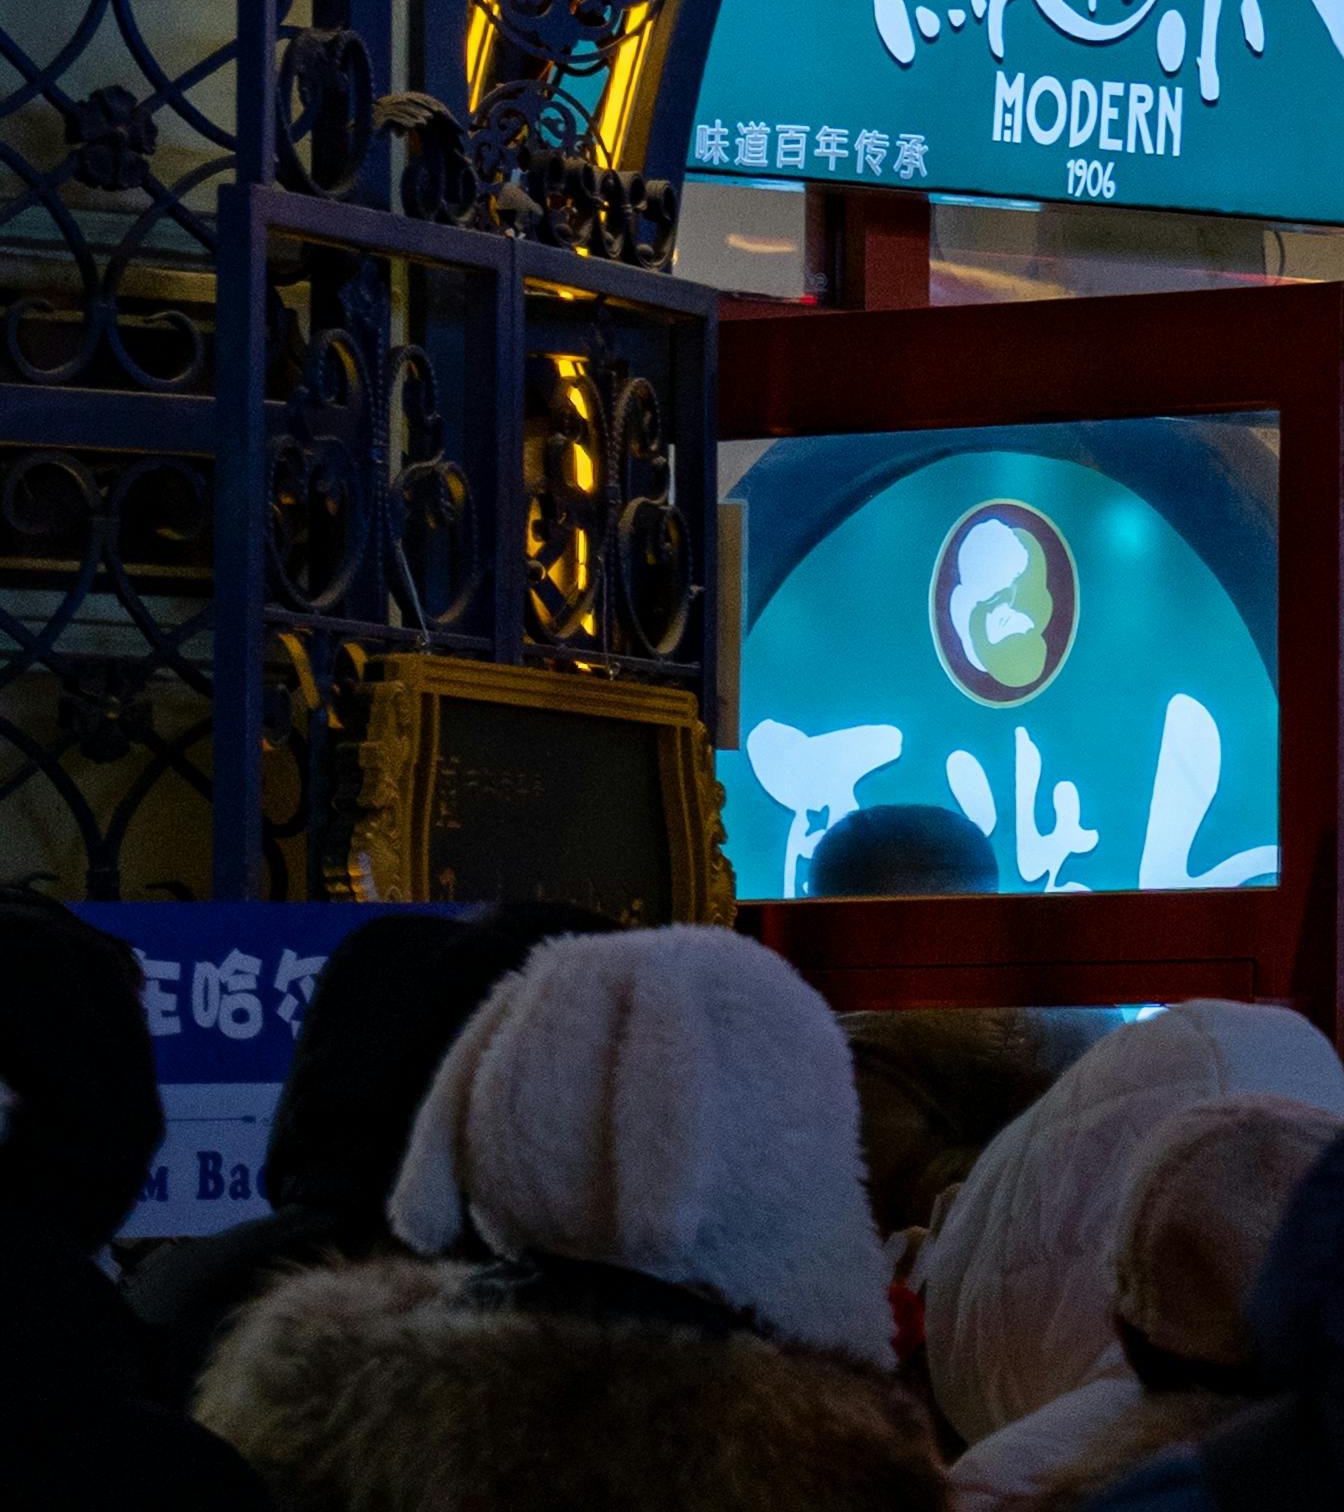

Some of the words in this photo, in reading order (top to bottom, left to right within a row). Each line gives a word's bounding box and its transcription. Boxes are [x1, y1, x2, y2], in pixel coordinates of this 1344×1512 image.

[992, 70, 1184, 157] MODERN
[694, 119, 929, 180] 味道百年传承
[1066, 158, 1117, 199] 1906
